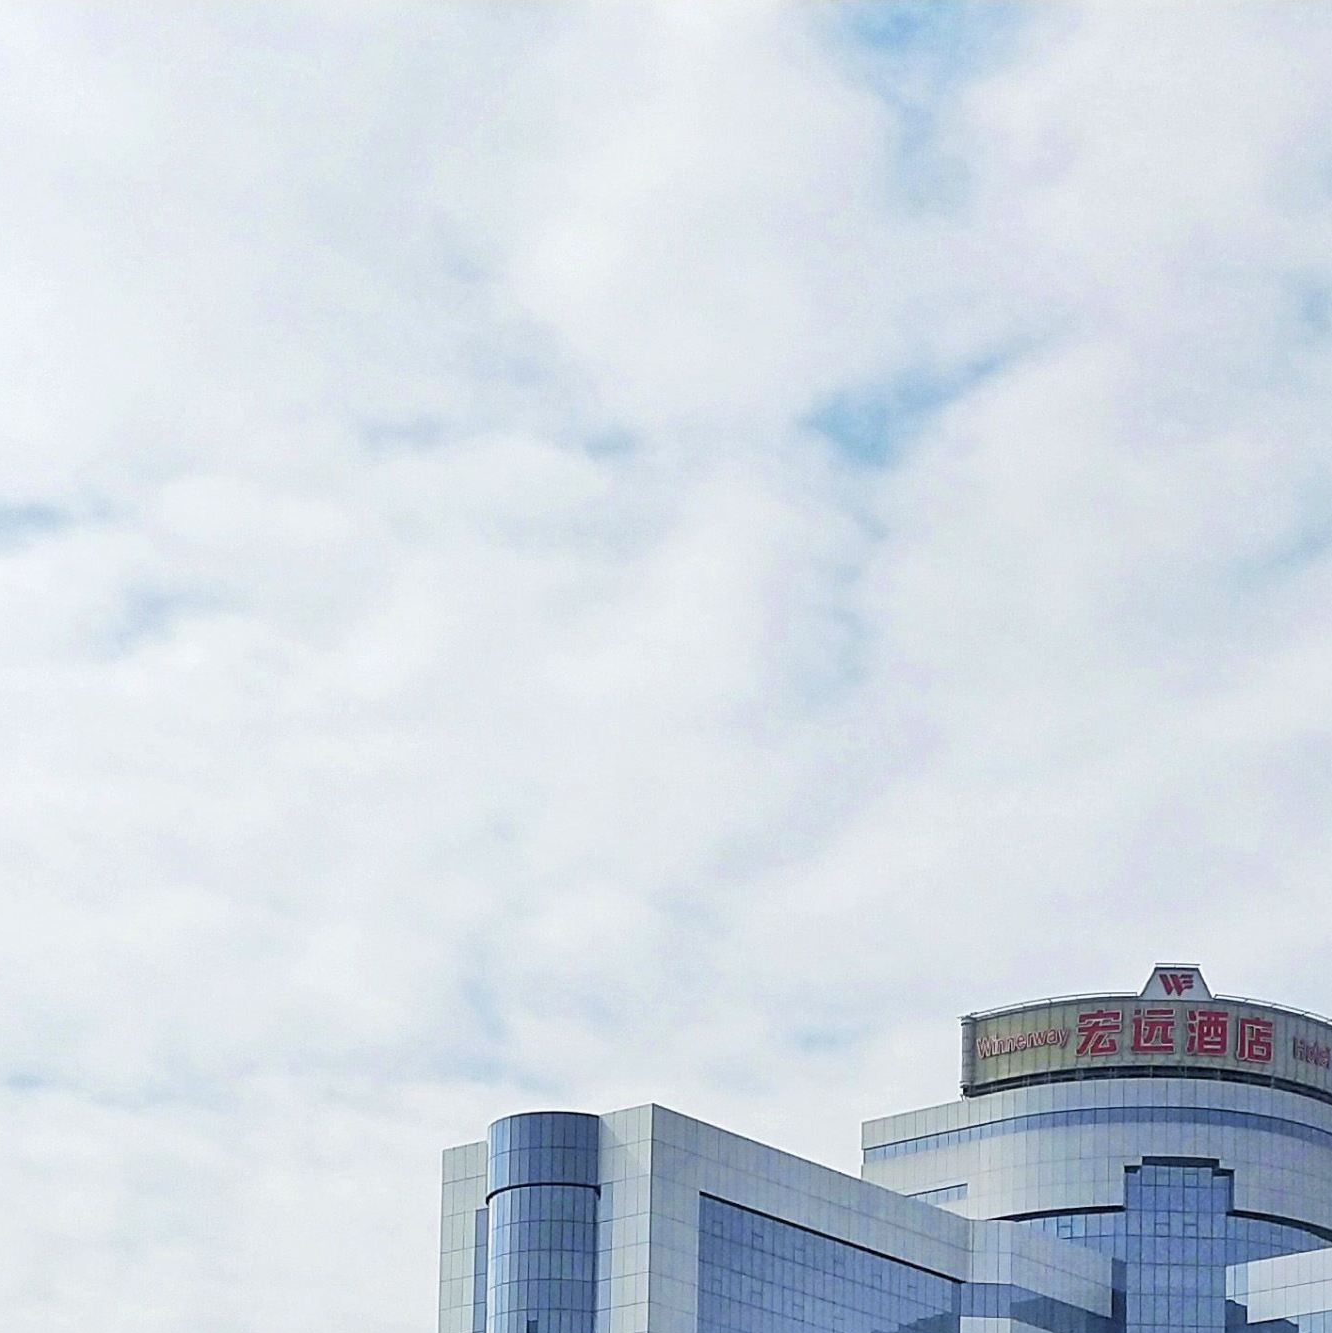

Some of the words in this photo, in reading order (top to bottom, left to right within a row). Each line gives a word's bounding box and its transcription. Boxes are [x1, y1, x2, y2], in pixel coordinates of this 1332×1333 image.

[976, 1029, 1069, 1059] Winnerway
[1076, 1008, 1274, 1063] 宏远酒店
[1293, 1037, 1331, 1069] Hotel
